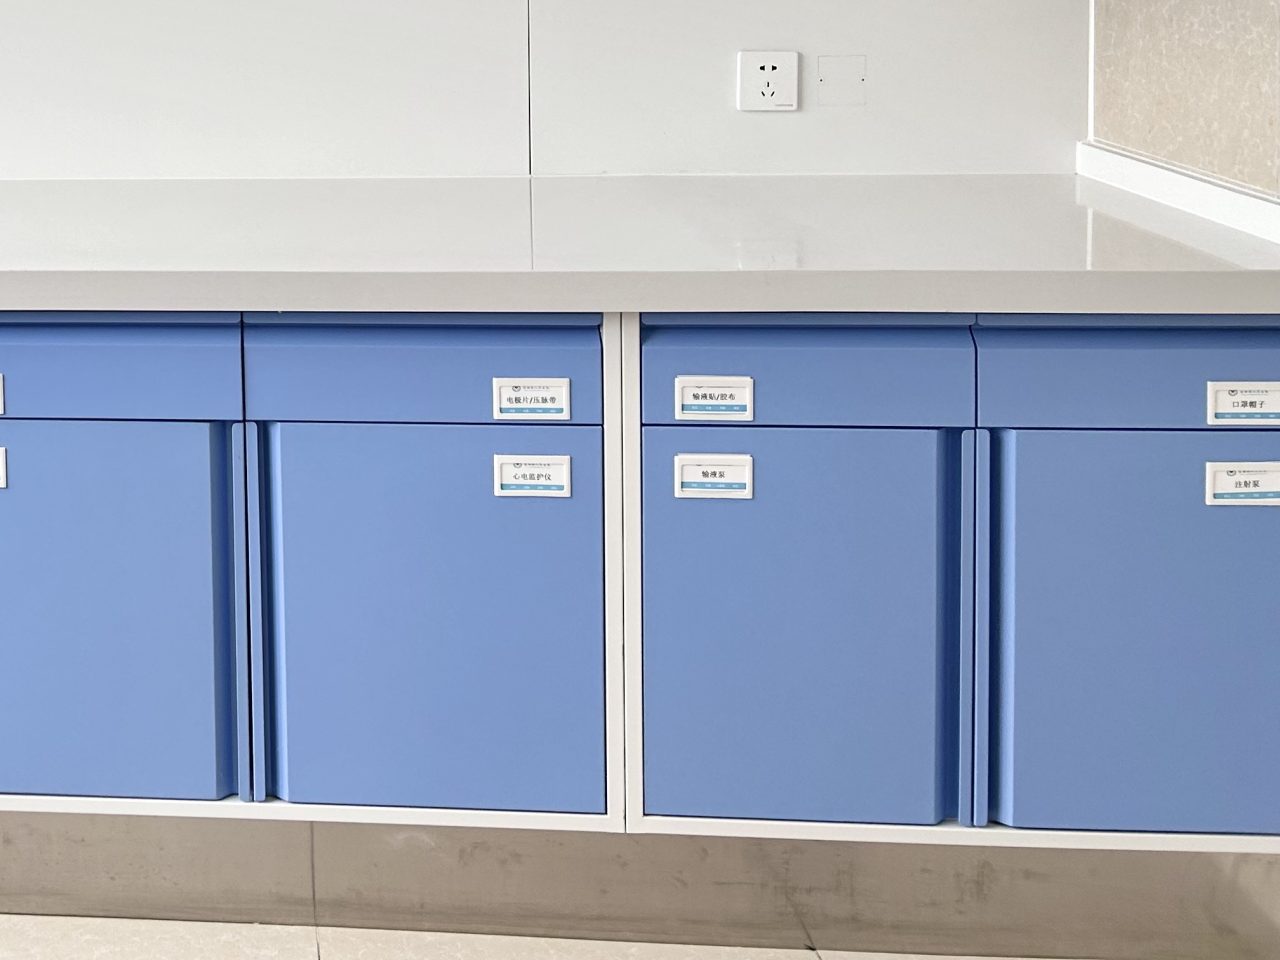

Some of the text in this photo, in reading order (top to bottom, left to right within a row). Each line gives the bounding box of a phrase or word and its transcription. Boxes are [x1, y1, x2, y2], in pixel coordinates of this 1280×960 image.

[506, 396, 557, 404] 电极片/压脉带
[692, 392, 736, 401] 输液贴/胶布
[1232, 400, 1265, 409] 口罩帽子
[512, 473, 552, 481] 心电监护仪
[701, 470, 726, 479] 输液泵
[1234, 480, 1261, 489] 注射泵
